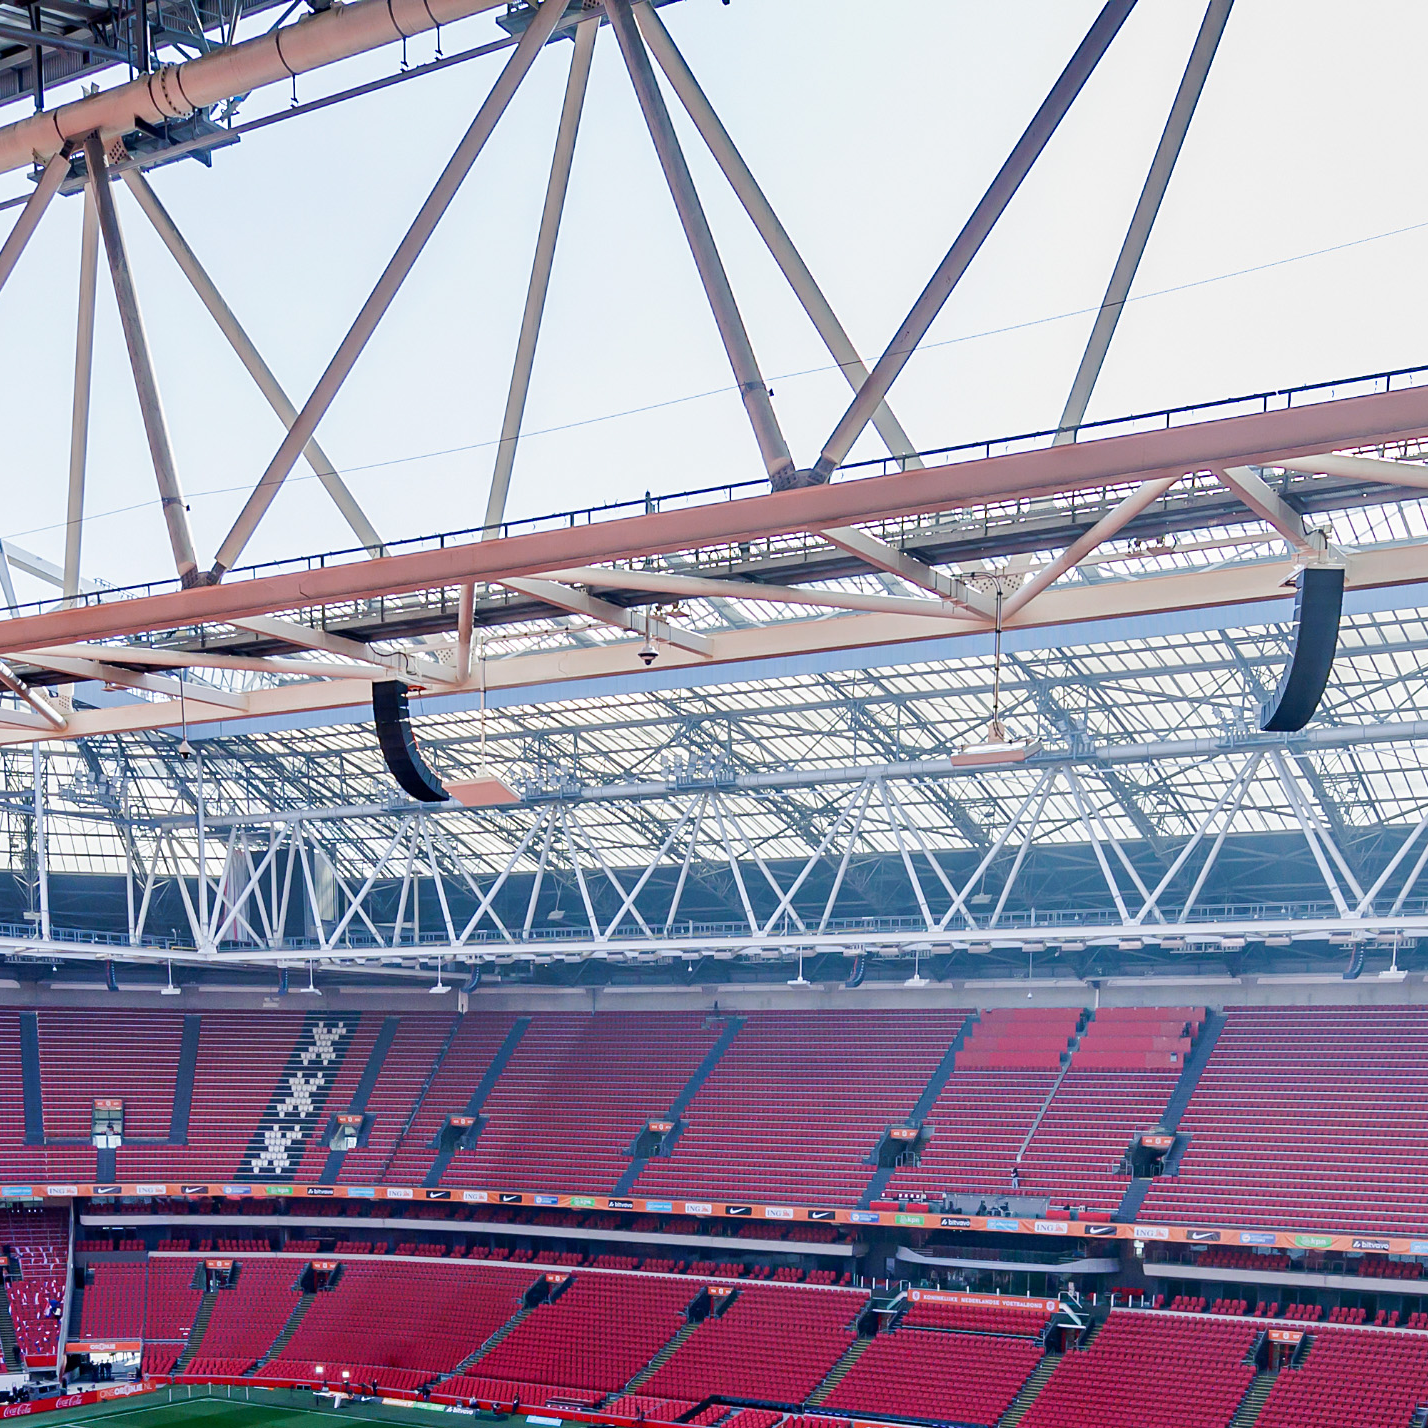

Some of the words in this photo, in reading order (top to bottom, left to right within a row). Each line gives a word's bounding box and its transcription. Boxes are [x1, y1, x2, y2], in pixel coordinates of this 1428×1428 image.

[767, 1209, 782, 1217] ING
[1036, 1224, 1054, 1232] ING
[1135, 1229, 1154, 1237] ING
[1361, 1240, 1389, 1249] bitvavo
